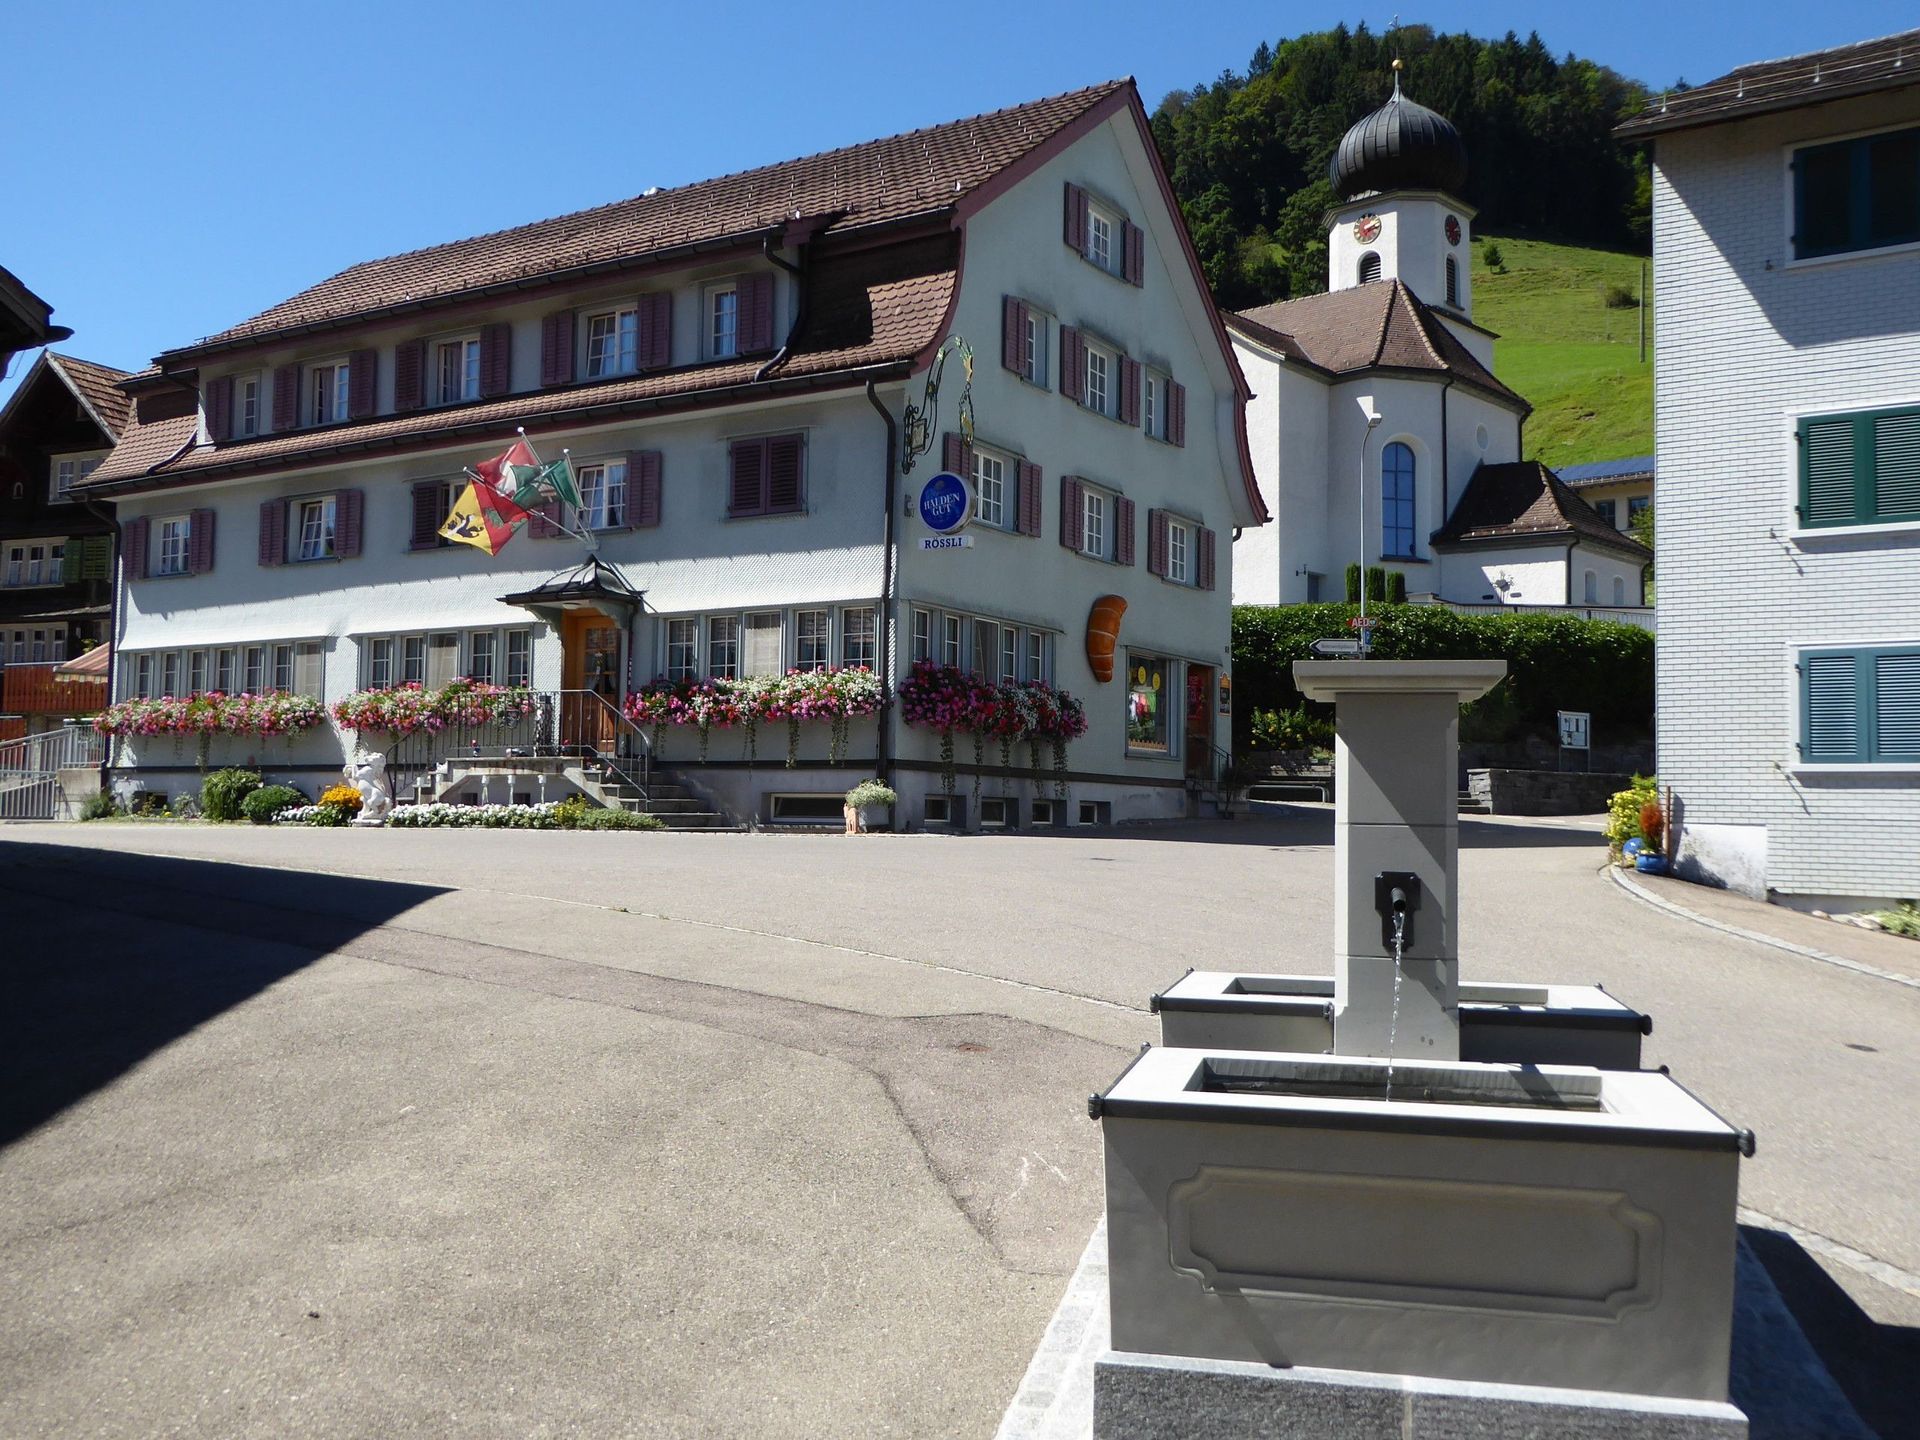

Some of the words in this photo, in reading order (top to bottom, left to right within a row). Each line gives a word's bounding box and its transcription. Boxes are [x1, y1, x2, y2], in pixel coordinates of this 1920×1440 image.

[924, 493, 960, 510] HALDEN
[932, 503, 952, 516] GUT
[925, 538, 962, 549] RÖSSLI
[1351, 617, 1369, 627] AED
